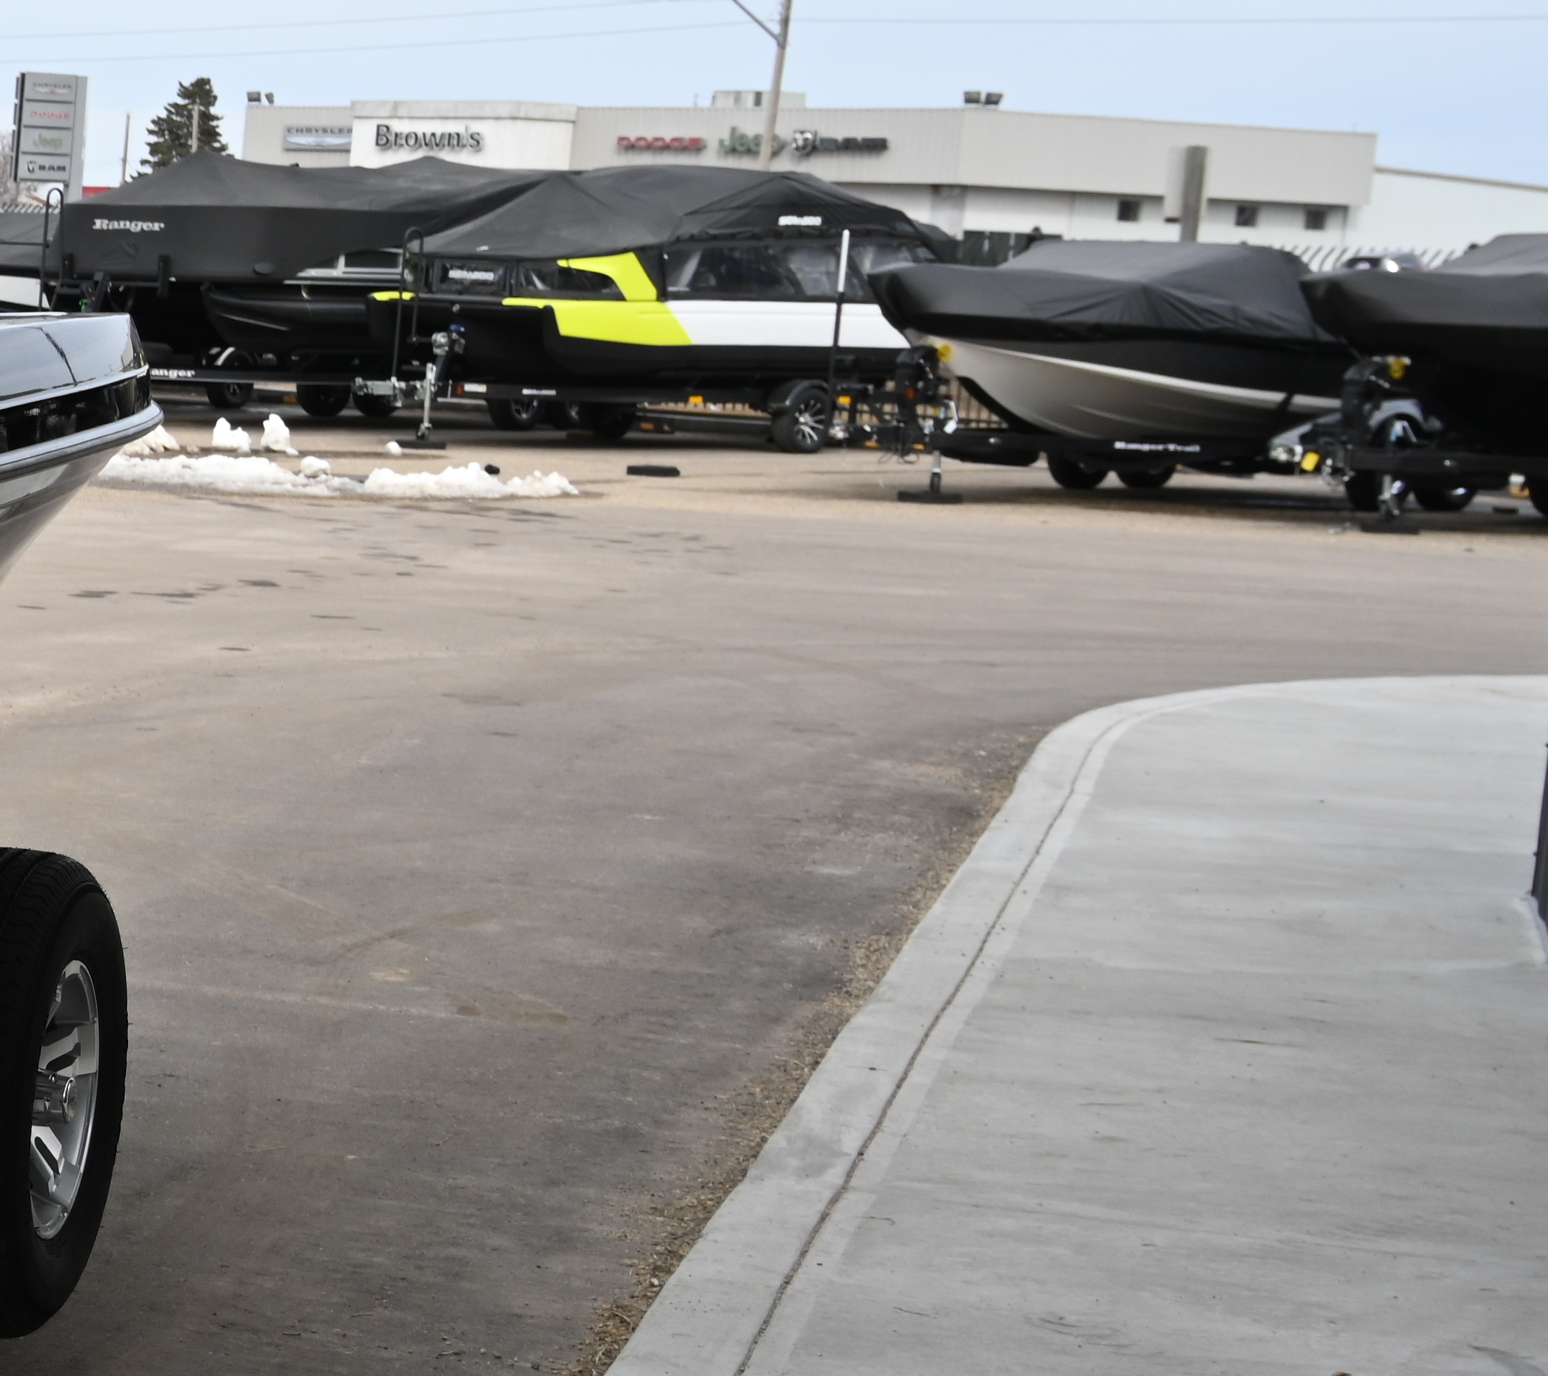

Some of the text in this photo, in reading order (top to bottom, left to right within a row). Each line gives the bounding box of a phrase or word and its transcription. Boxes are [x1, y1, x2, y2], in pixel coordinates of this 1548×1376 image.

[374, 124, 482, 150] Brown's
[617, 136, 703, 150] DODGE
[92, 218, 165, 232] Ranger
[150, 367, 196, 379] anger
